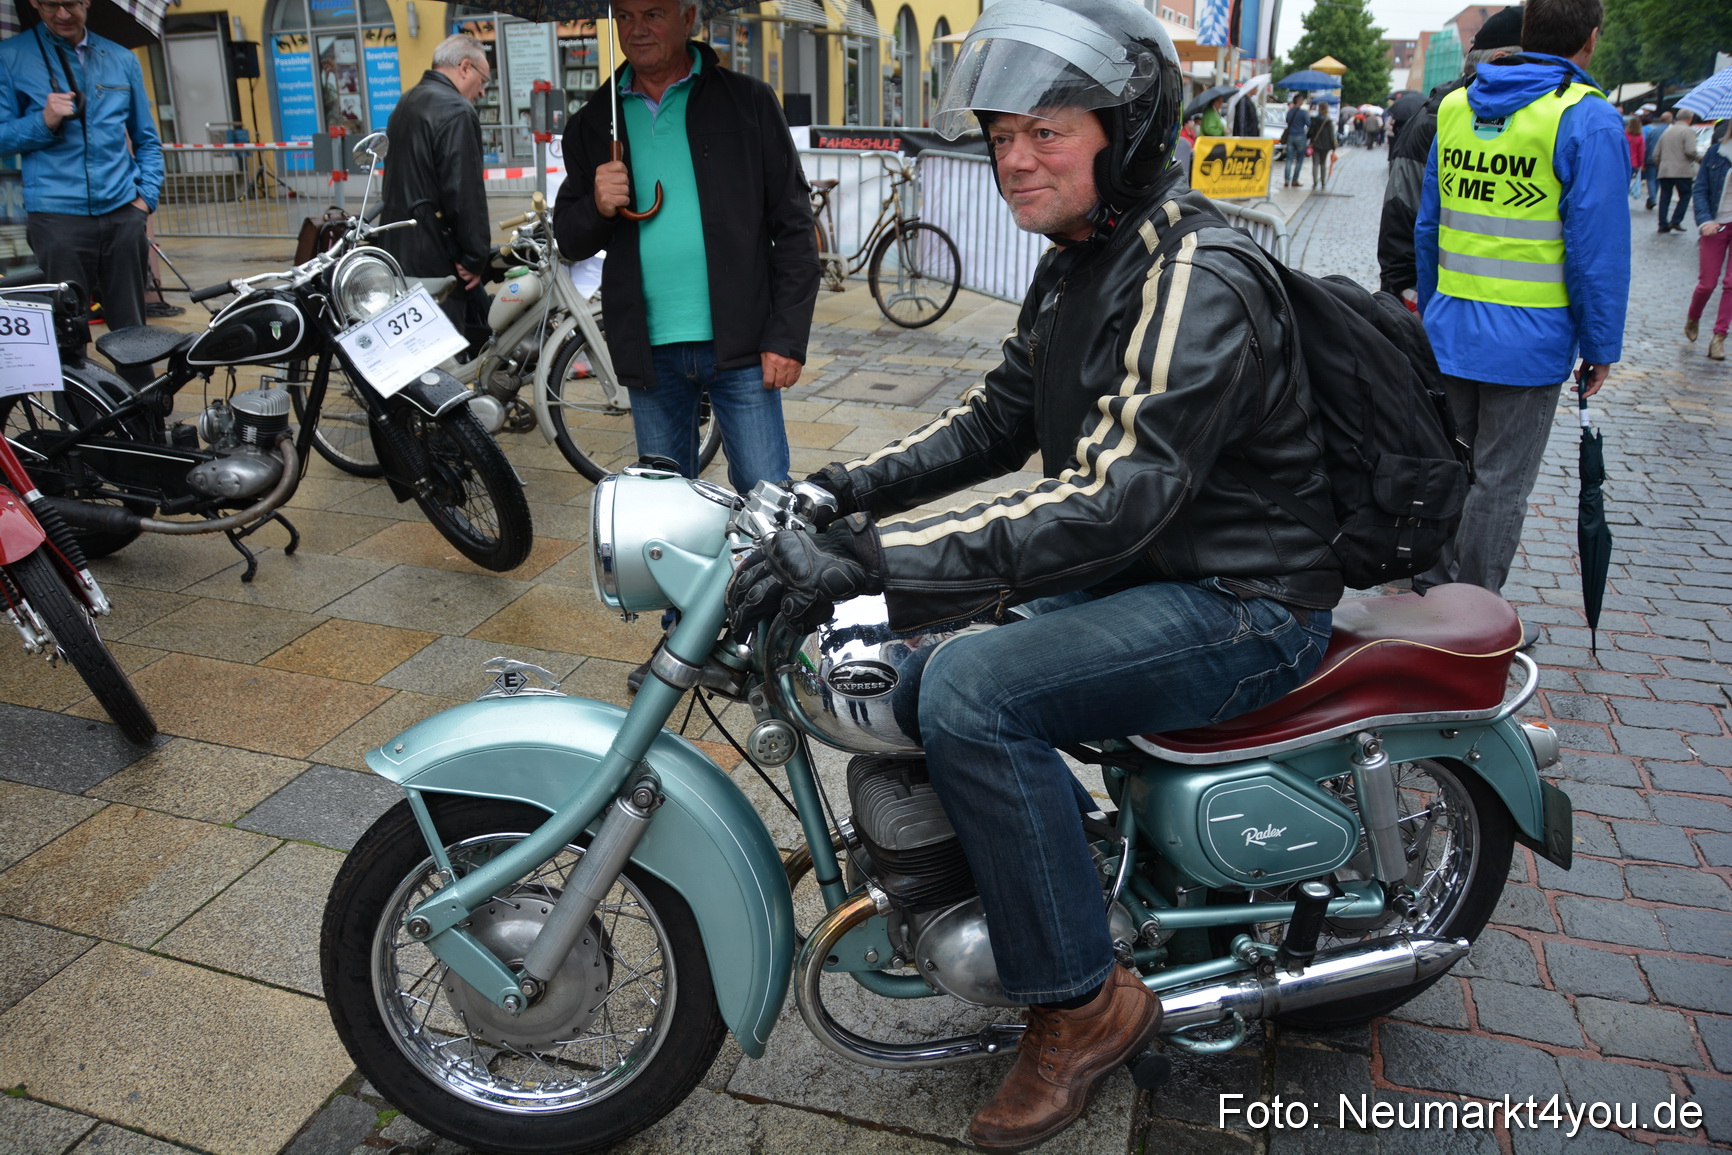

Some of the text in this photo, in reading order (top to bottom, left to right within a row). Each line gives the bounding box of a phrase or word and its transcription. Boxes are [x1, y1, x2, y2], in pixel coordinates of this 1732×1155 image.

[275, 56, 311, 65] Passbilder
[818, 136, 901, 150] FAHRSCHULE
[1223, 157, 1255, 175] Dietz
[1443, 148, 1538, 178] FOLLOW
[1457, 177, 1497, 202] ME
[388, 307, 423, 335] 373
[836, 681, 886, 691] EXPRESS
[1241, 823, 1287, 846] Radex
